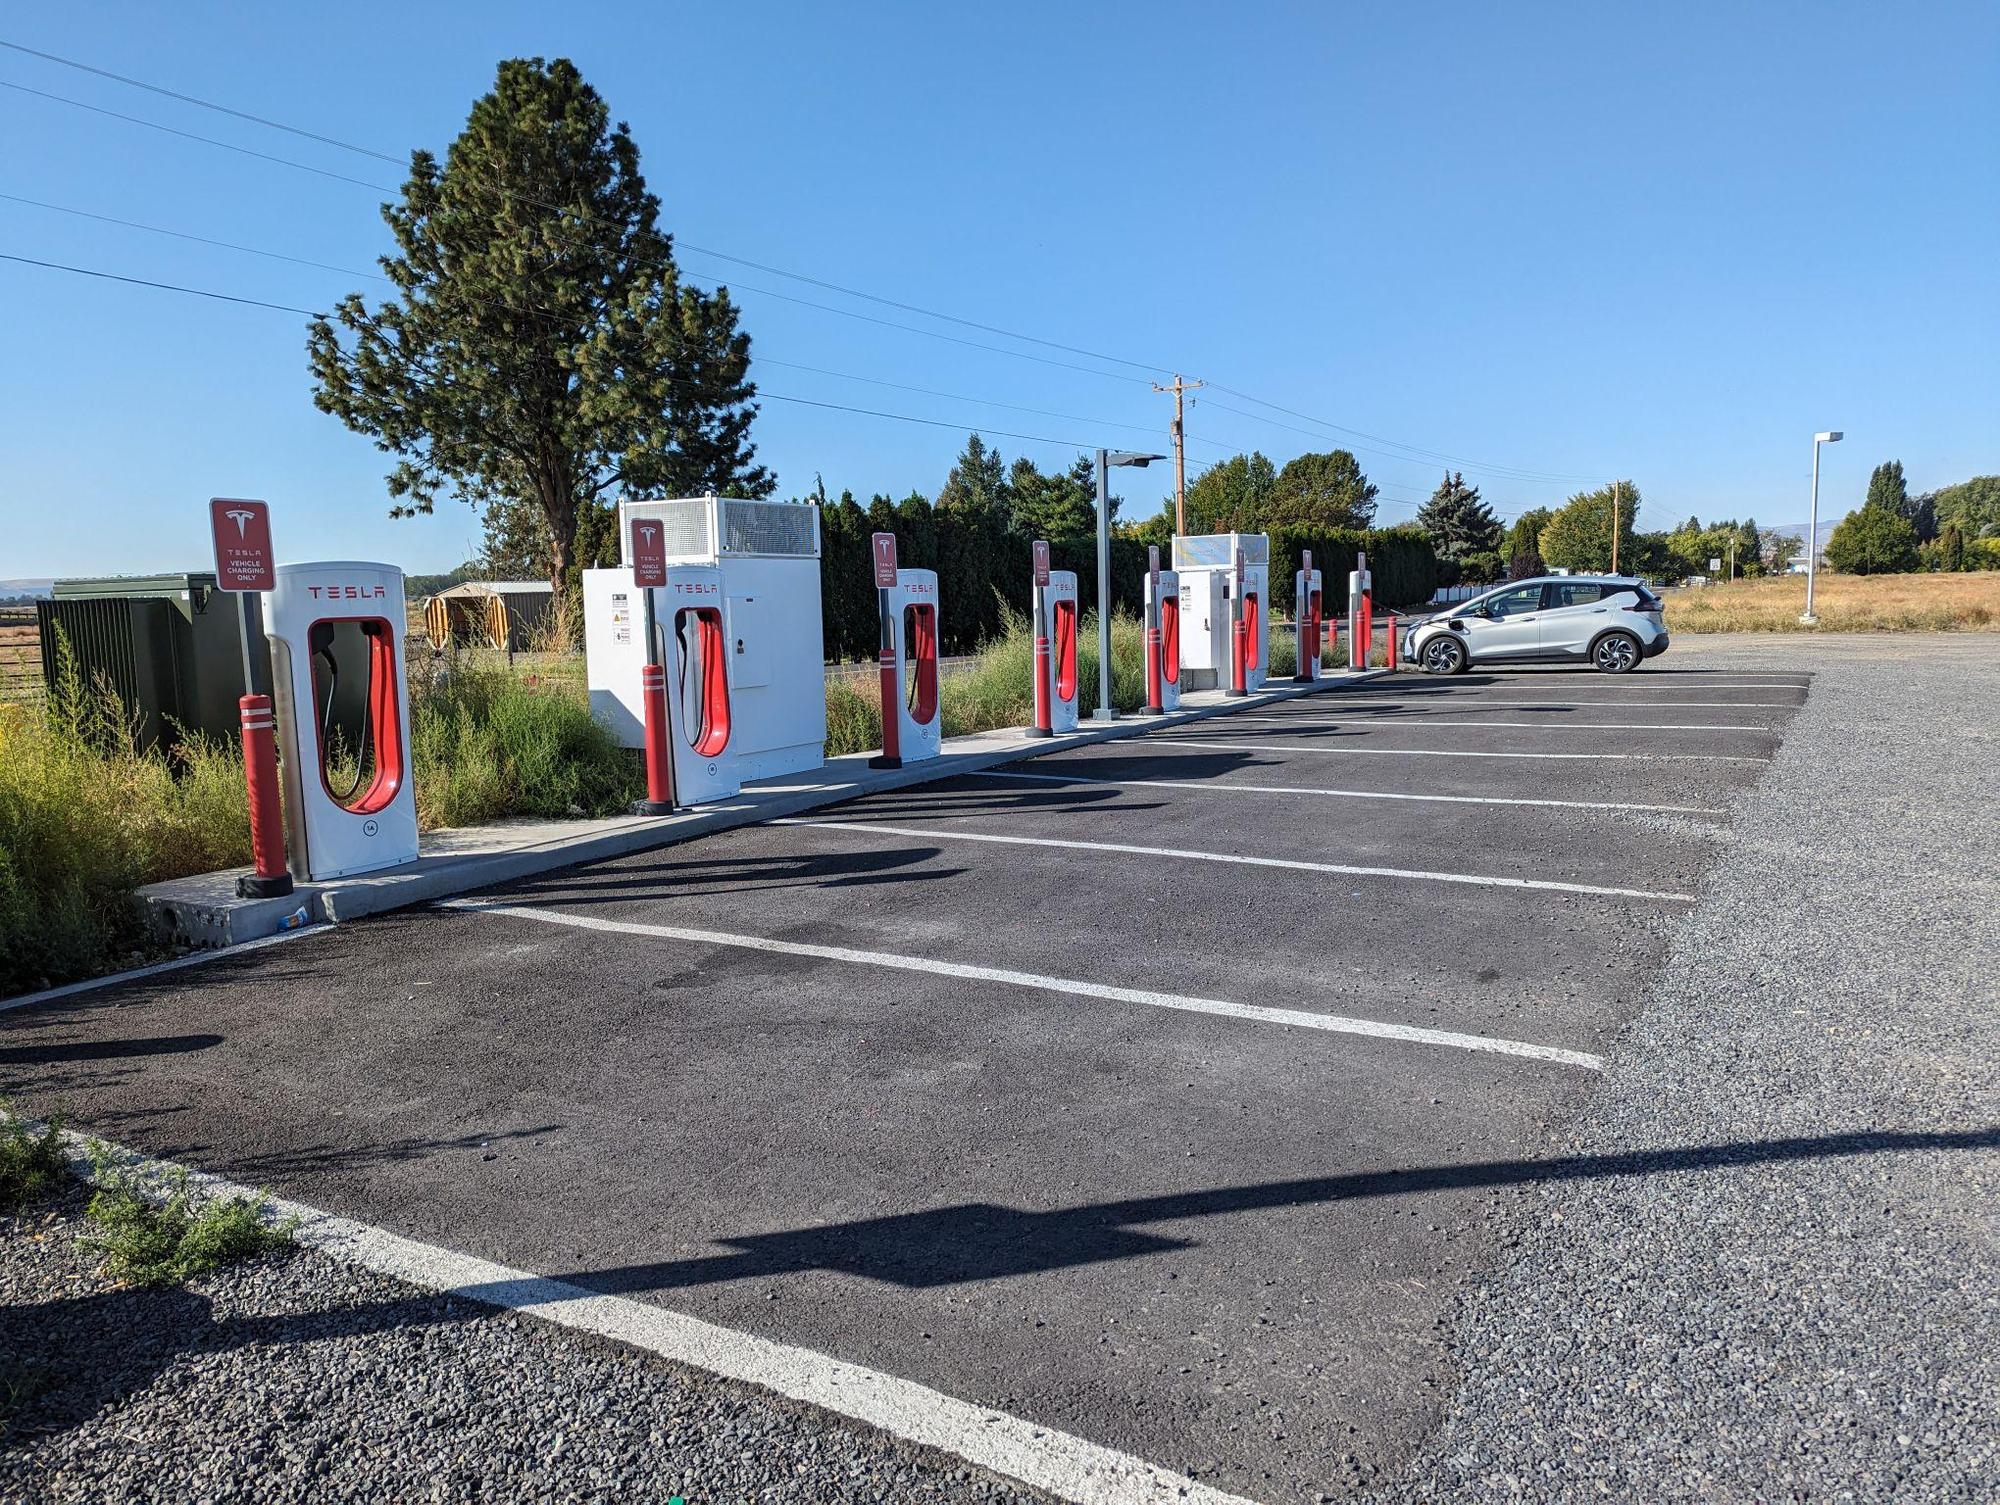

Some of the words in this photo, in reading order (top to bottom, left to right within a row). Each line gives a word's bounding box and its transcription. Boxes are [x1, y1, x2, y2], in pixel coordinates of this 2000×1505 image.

[308, 586, 385, 599] TESLA
[675, 584, 718, 593] TESLA
[904, 584, 933, 593] TESLA
